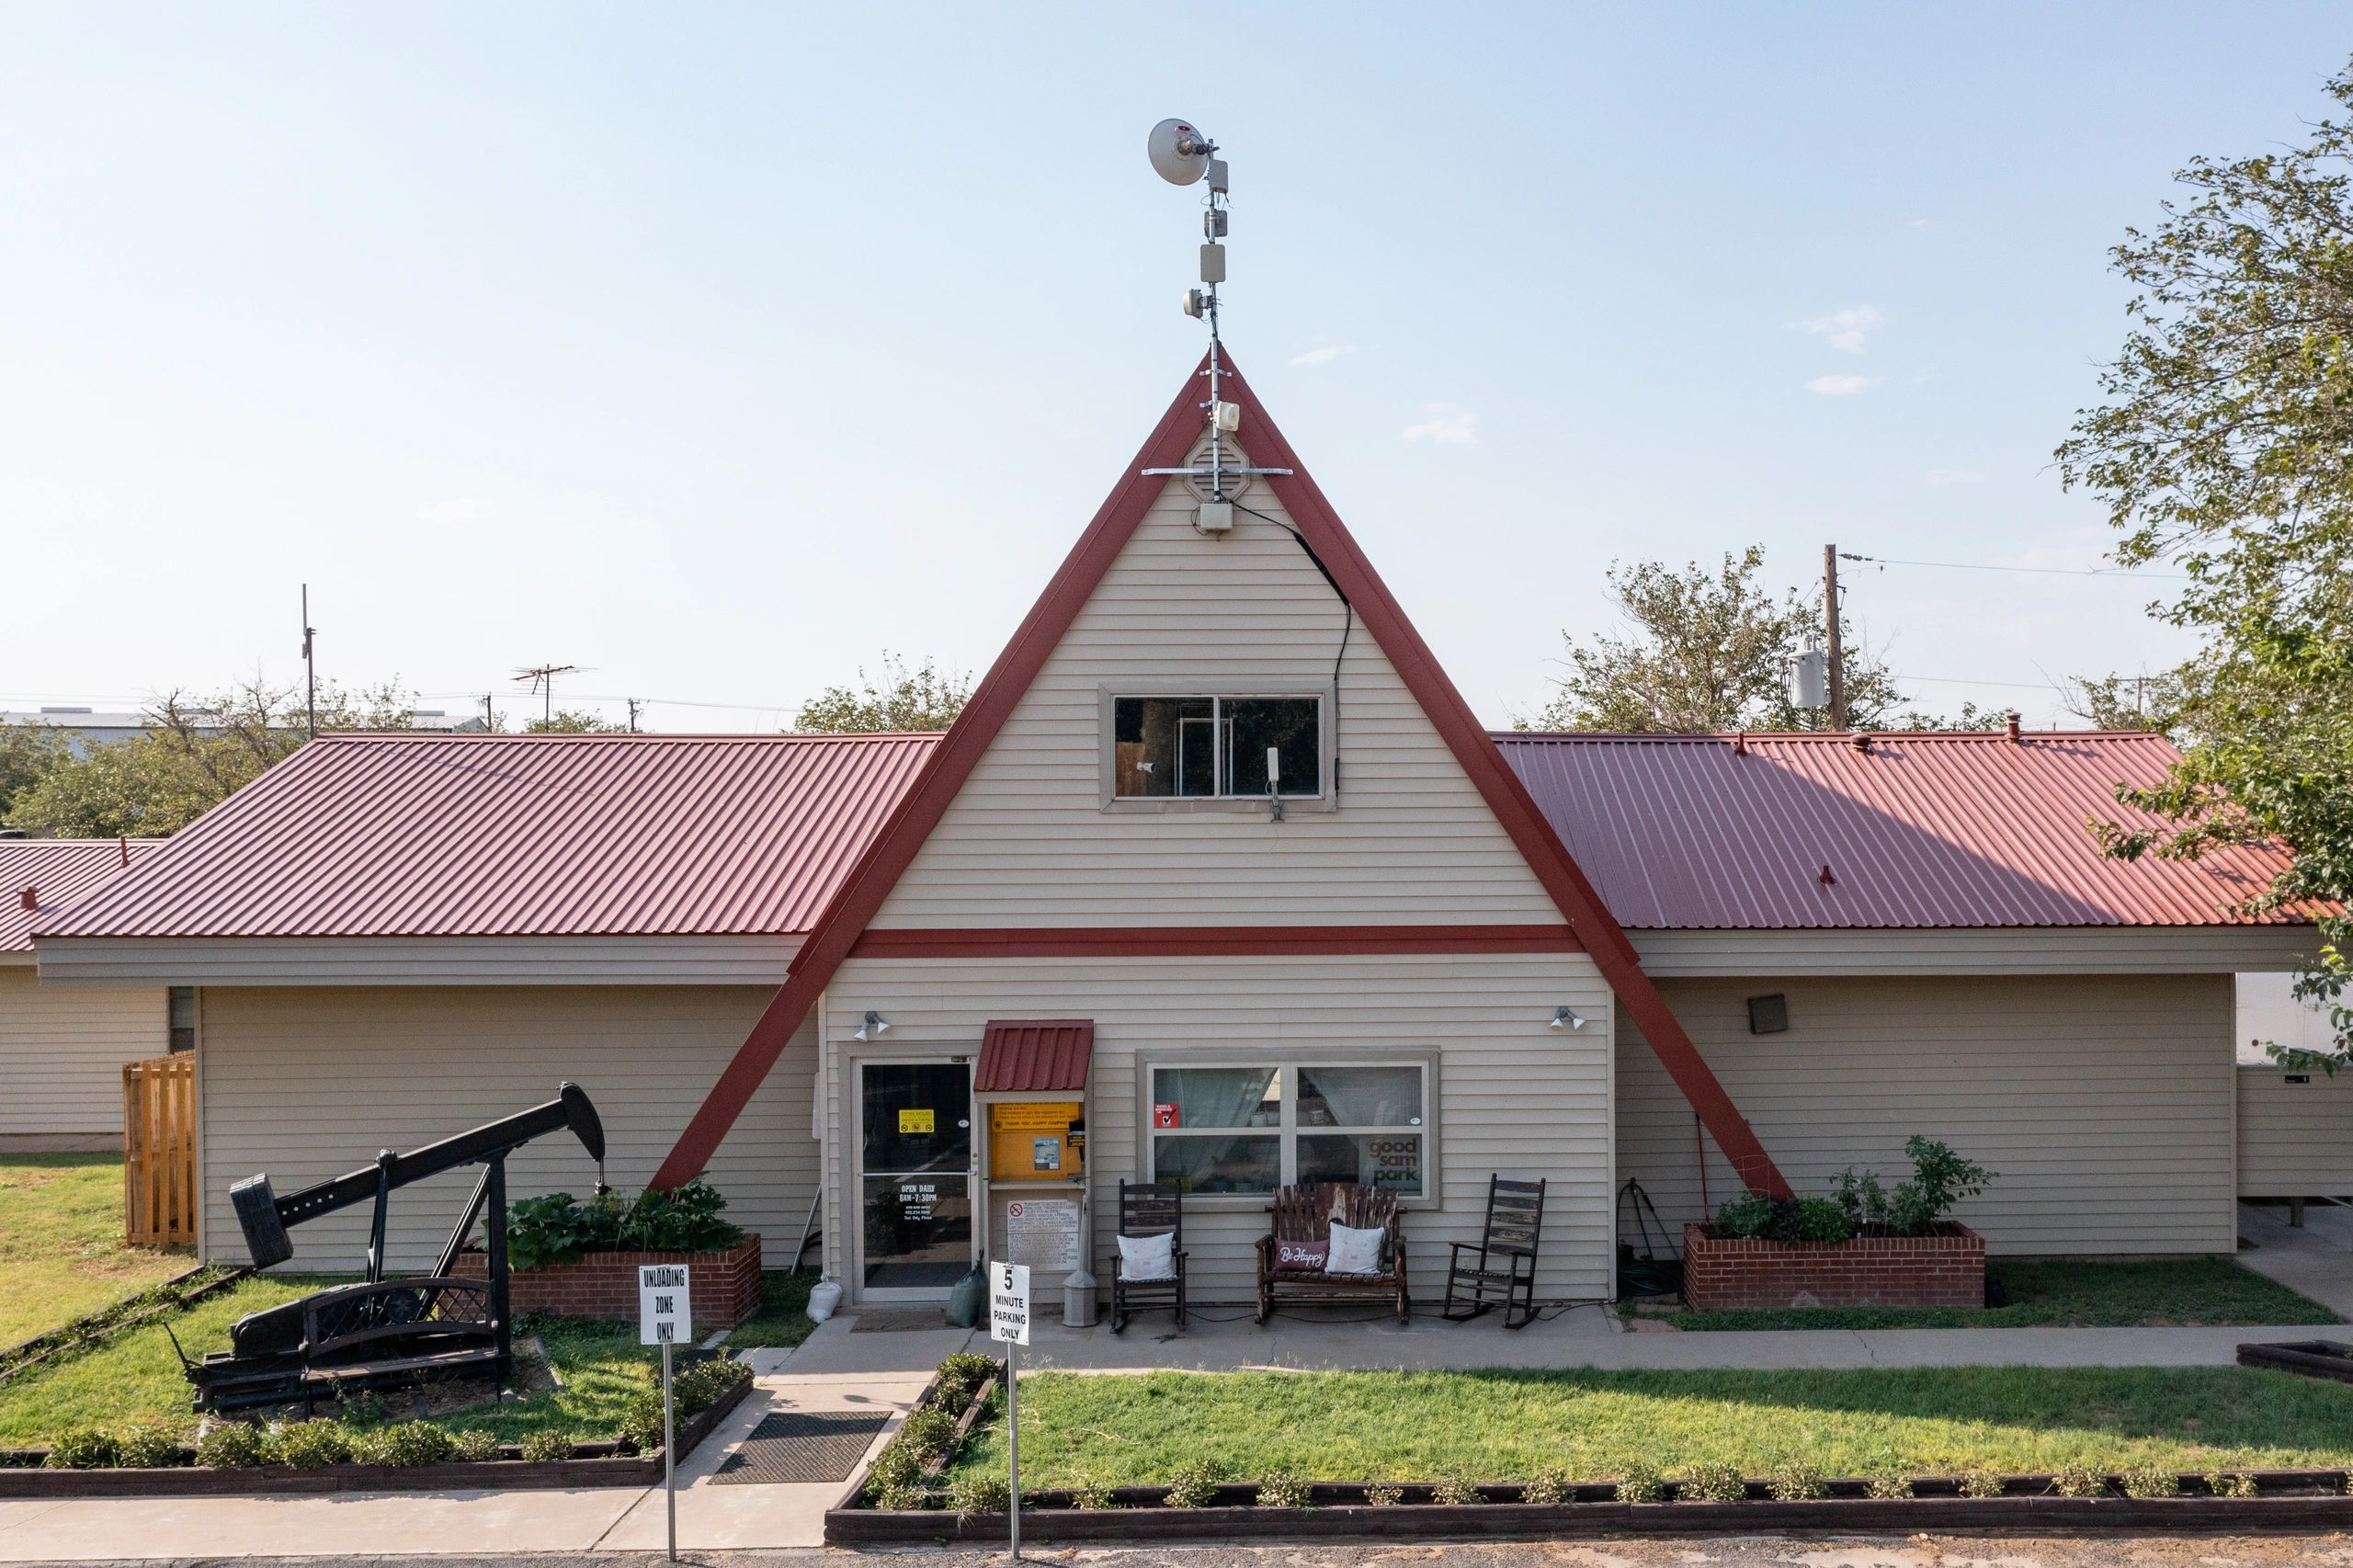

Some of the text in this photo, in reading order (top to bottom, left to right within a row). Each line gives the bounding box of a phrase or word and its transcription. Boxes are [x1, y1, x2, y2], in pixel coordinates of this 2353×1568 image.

[1370, 1137, 1416, 1157] good
[1380, 1155, 1416, 1166] sam
[1374, 1167, 1417, 1187] park
[901, 1185, 936, 1193] OPEN DAILY
[1280, 1246, 1324, 1267] Be Happy
[643, 1269, 685, 1288] UNLOADING
[1004, 1269, 1013, 1290] 5
[655, 1296, 674, 1314] ZONE
[995, 1294, 1024, 1309] MINUTE
[994, 1310, 1026, 1325] PARKING
[656, 1322, 675, 1340] ONLY
[1000, 1327, 1020, 1340] ONLY
